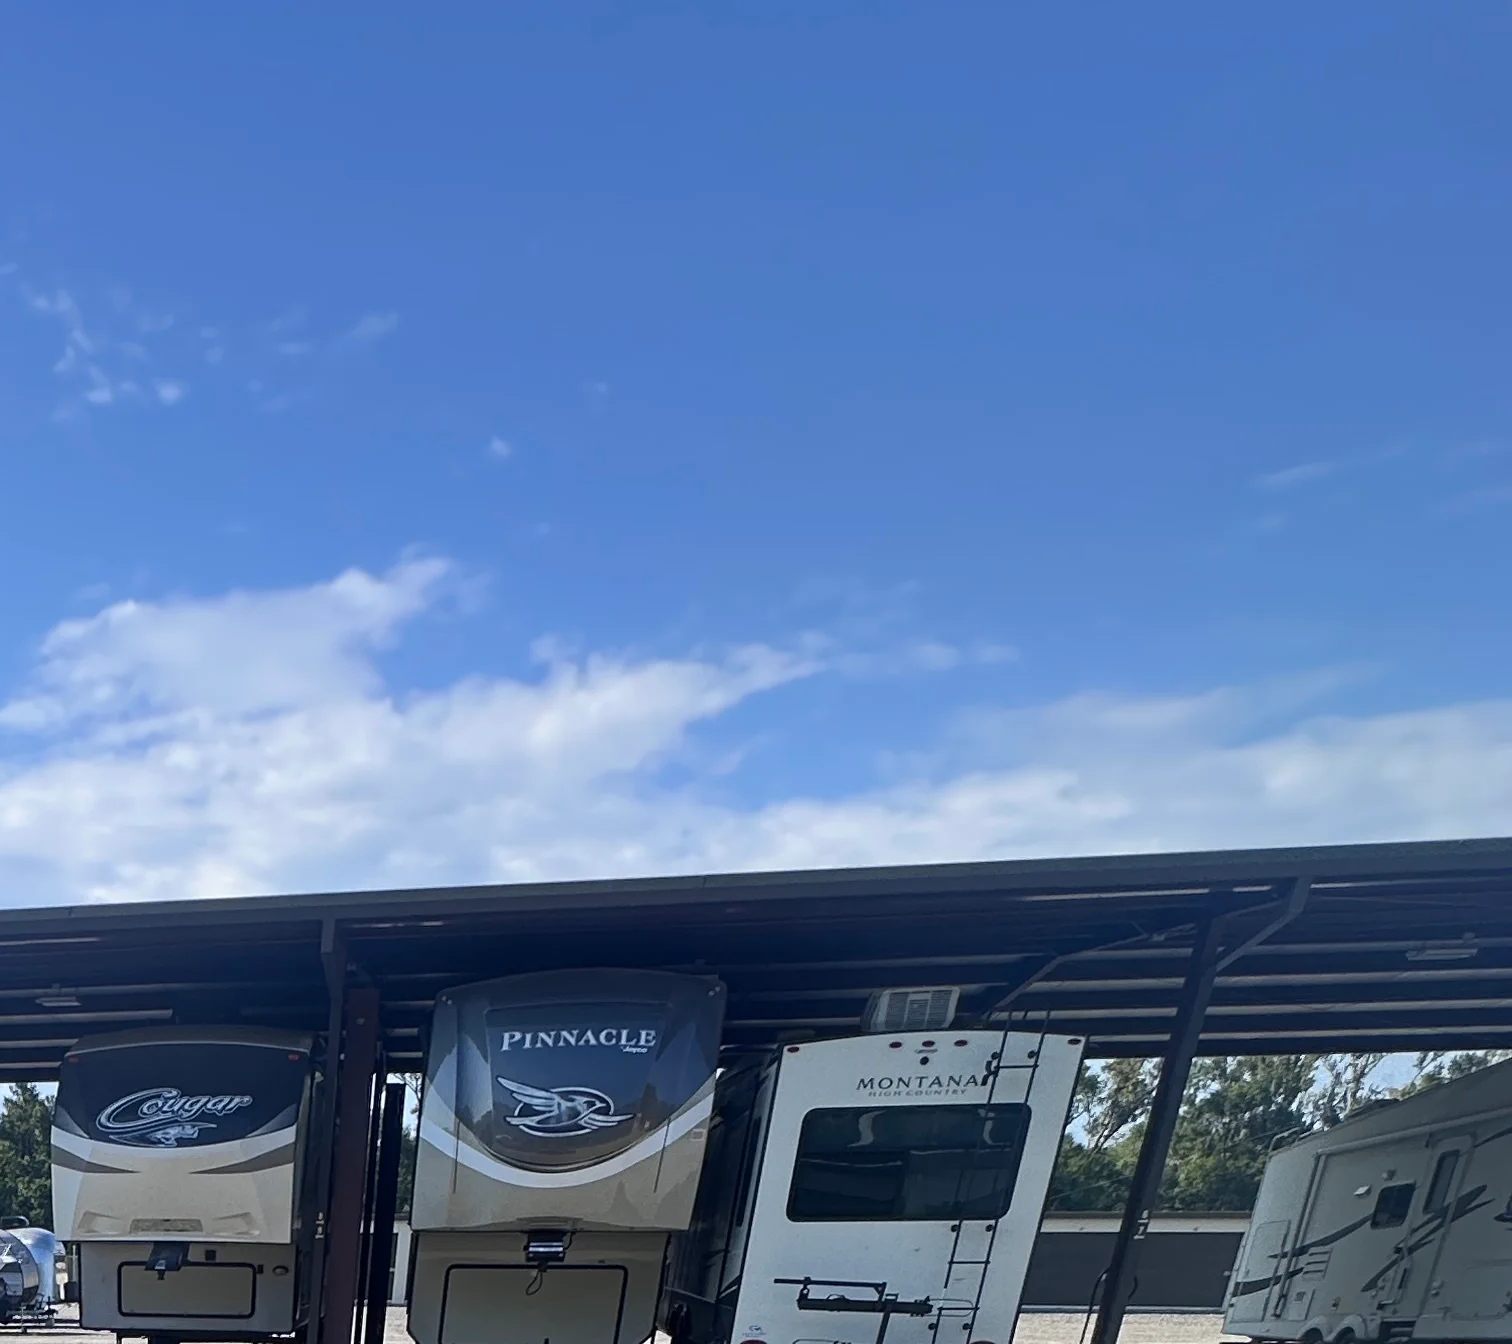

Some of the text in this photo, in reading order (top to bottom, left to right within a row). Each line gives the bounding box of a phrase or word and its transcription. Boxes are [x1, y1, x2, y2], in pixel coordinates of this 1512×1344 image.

[500, 1028, 657, 1052] PINNACLE
[856, 1074, 979, 1091] MONTANA
[868, 1087, 967, 1098] HIGH COUNTRY
[96, 1087, 253, 1132] Cougar
